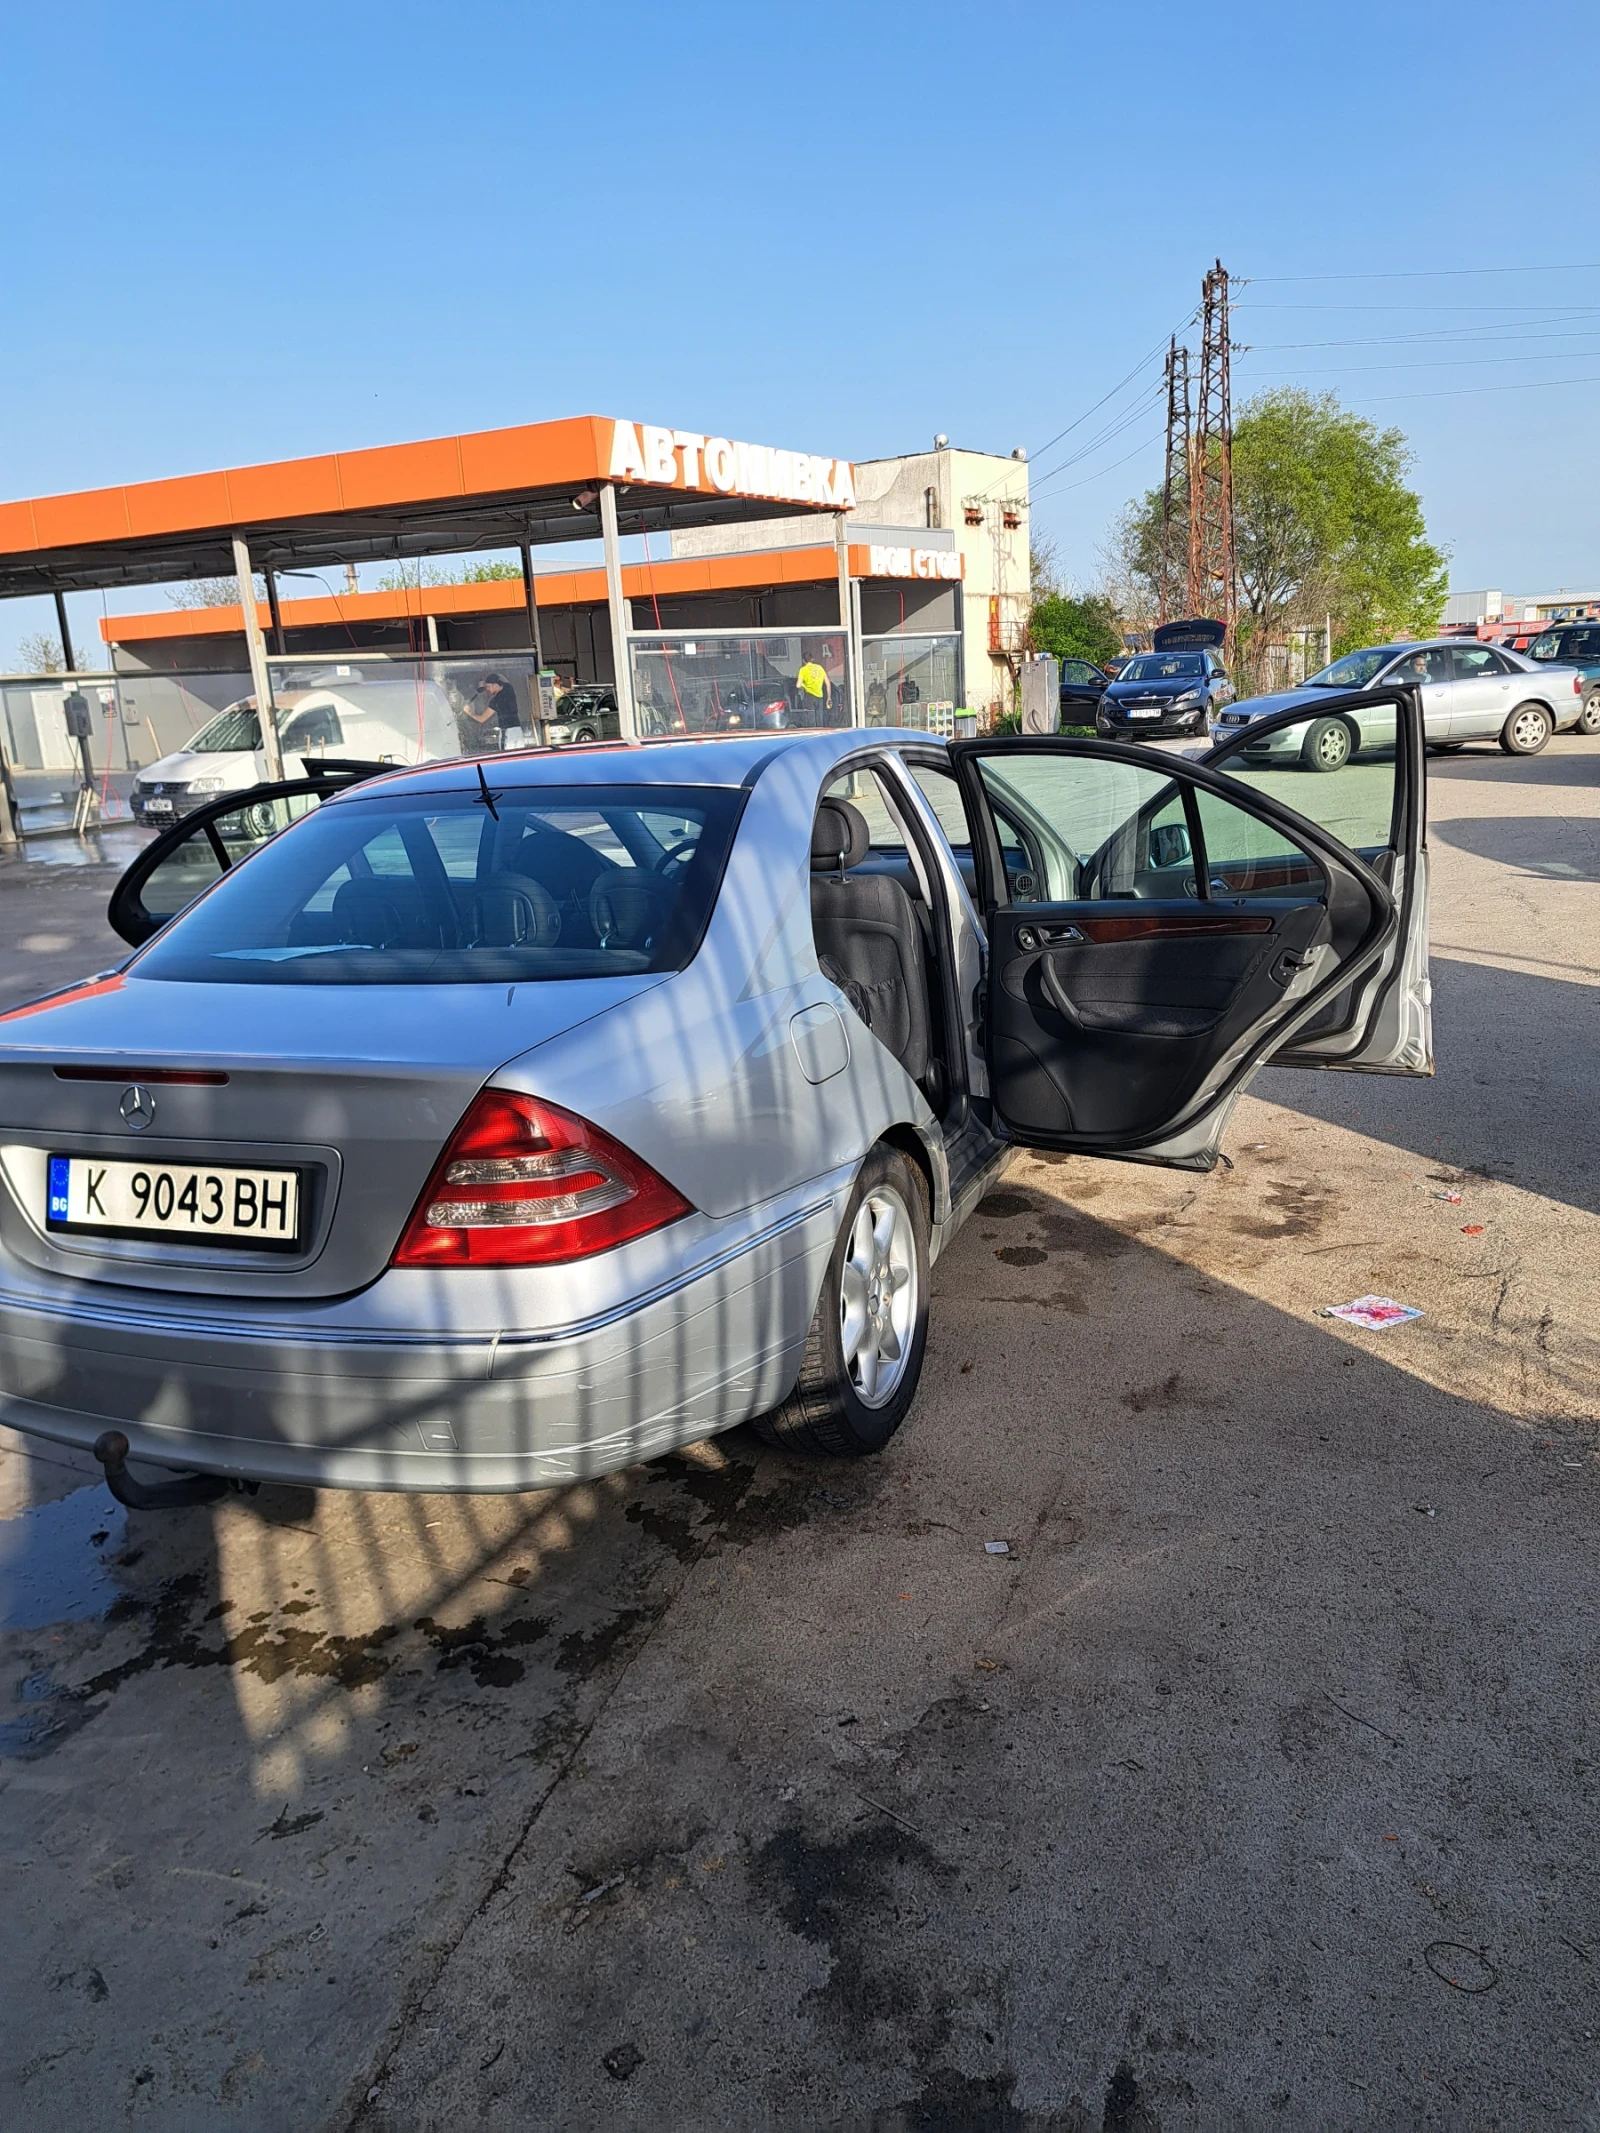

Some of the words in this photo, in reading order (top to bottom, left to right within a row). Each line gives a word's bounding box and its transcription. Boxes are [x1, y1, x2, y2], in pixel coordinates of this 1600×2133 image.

[609, 419, 857, 508] АВТОМИВКА
[870, 545, 912, 576] НОН
[914, 549, 961, 579] СТОП
[52, 1197, 67, 1211] BG
[86, 1167, 108, 1217] K
